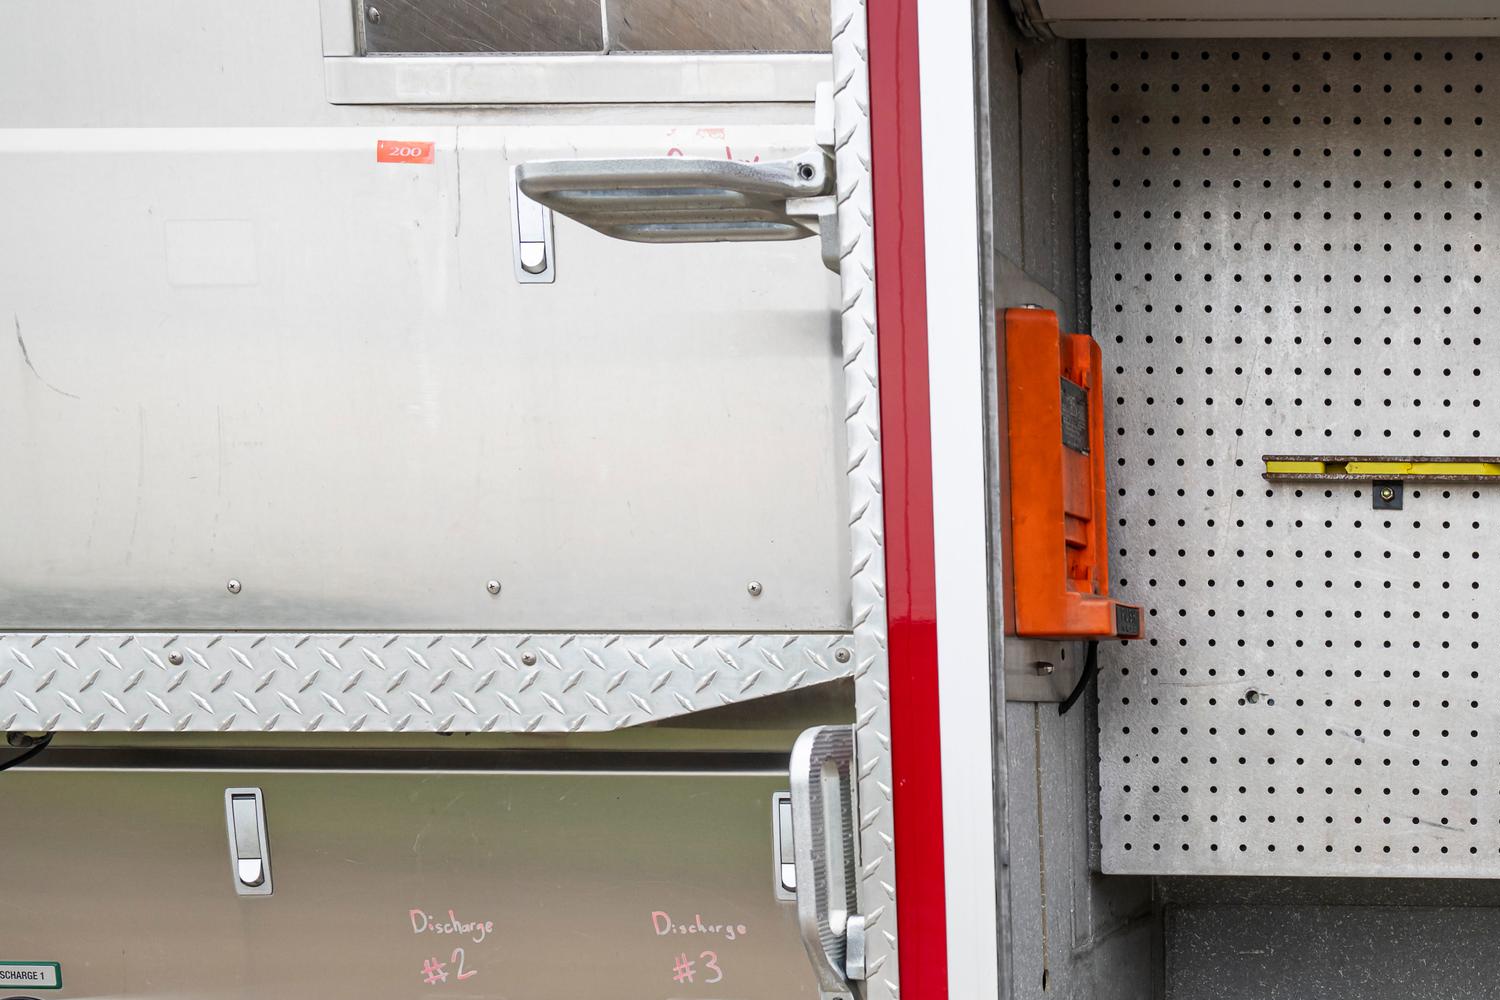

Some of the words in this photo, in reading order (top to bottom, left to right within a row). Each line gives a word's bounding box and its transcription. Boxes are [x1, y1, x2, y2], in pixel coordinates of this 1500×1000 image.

[390, 147, 421, 157] 200
[409, 909, 494, 943] Discharge
[651, 911, 746, 940] Discharge
[40, 971, 45, 980] 1
[421, 948, 478, 984] #2
[672, 951, 723, 983] #3
